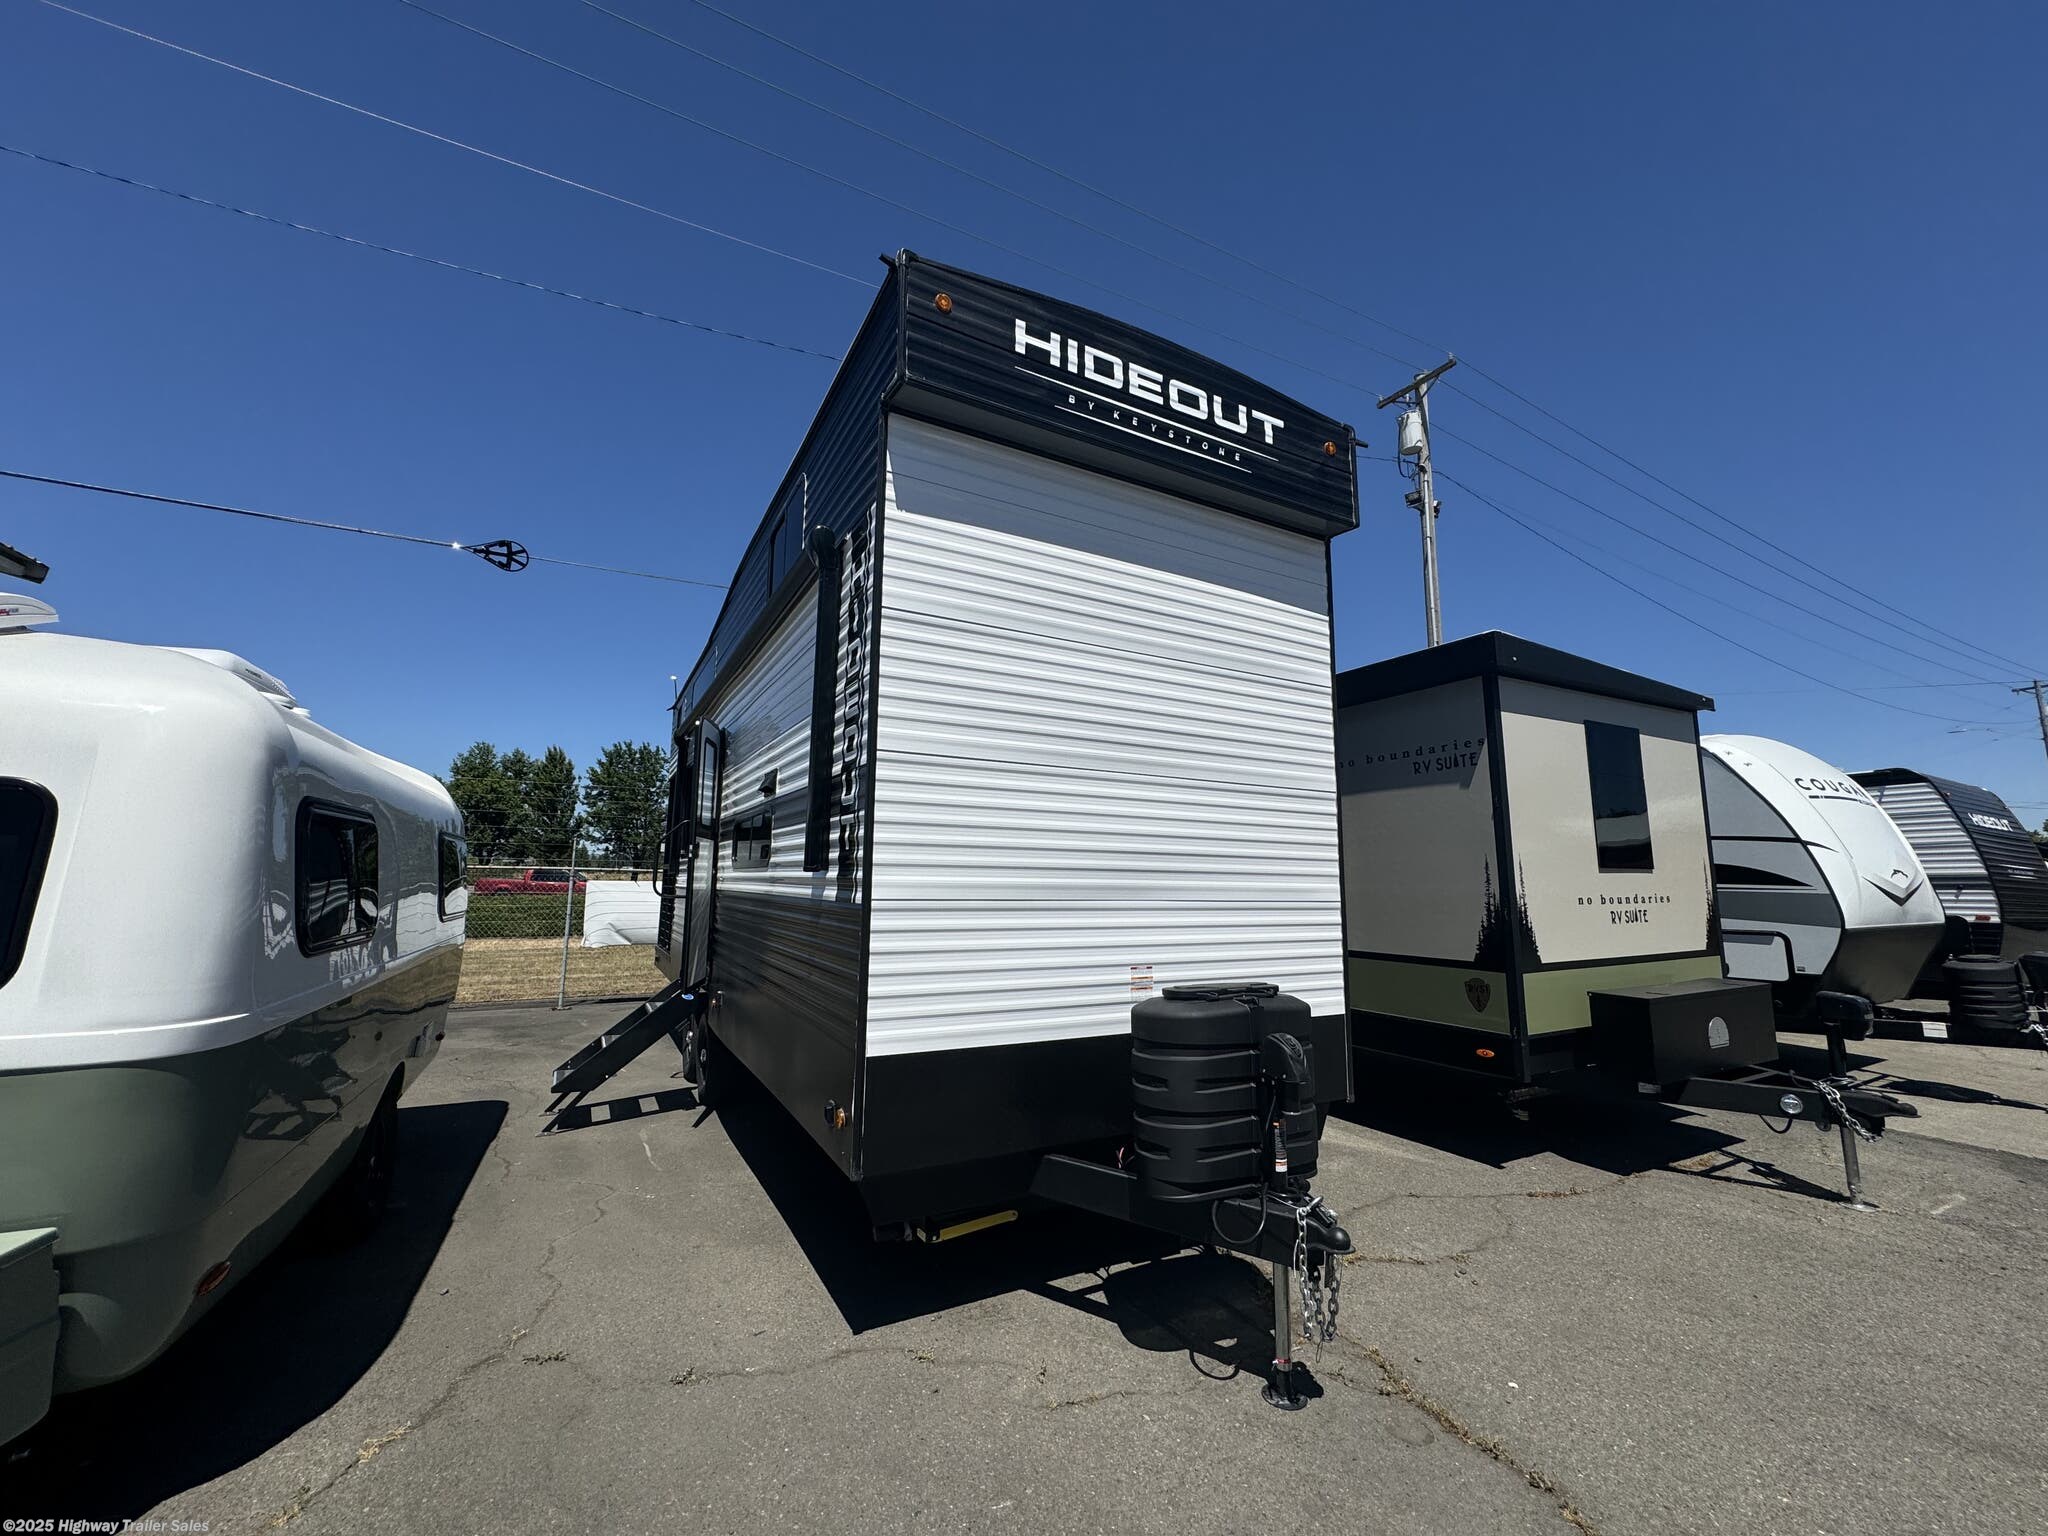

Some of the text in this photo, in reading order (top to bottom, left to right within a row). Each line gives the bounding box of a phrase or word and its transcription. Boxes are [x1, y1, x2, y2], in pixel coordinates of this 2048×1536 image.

[1014, 318, 1284, 445] HIDEOUT
[1068, 394, 1241, 461] BY KEYSTONE
[1366, 738, 1485, 764] boundaries
[1412, 759, 1431, 775] RV
[1968, 812, 2013, 832] HIDEOUT
[1578, 893, 1671, 905] no boundaries
[1610, 910, 1622, 924] RV
